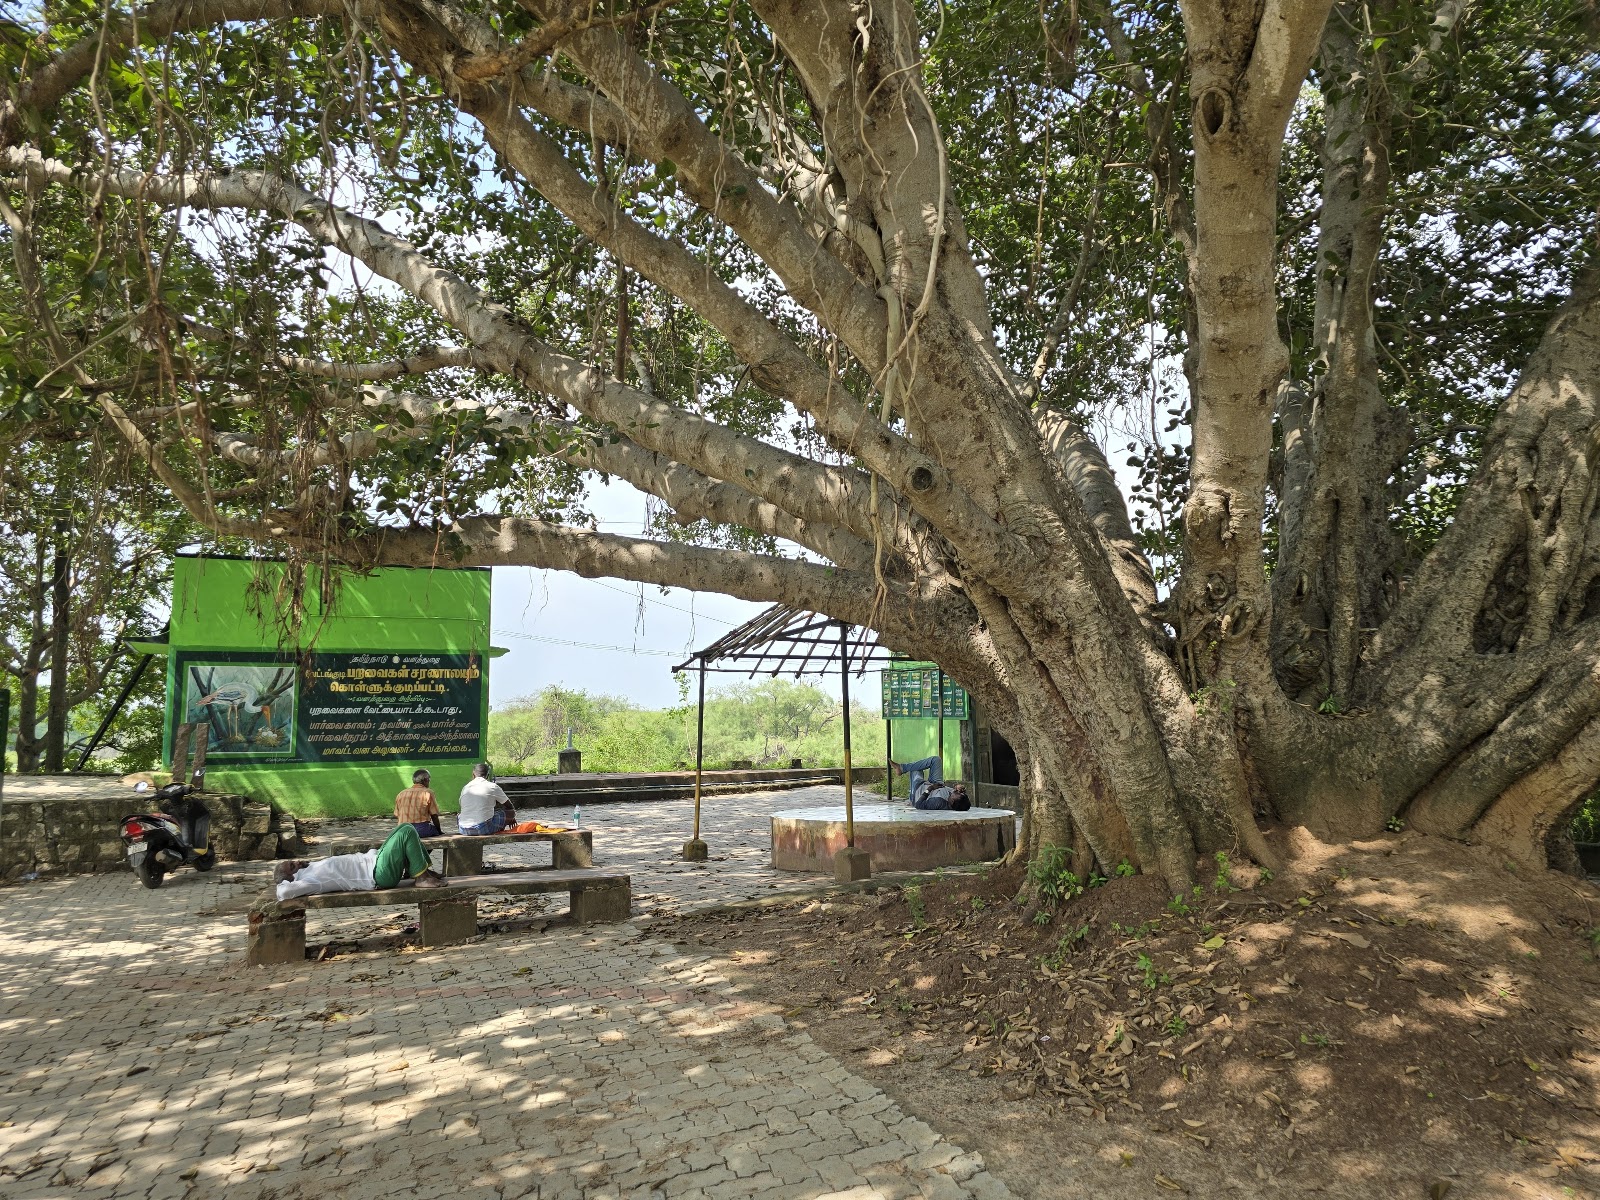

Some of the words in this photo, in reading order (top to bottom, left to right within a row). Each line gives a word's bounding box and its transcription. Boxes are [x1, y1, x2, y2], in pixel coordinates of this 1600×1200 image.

[347, 664, 410, 680] பறவைகள்
[410, 664, 480, 680] சரணாலயம்
[378, 719, 412, 730] நவம்பர்
[431, 718, 456, 728] மார்ச்
[375, 732, 420, 742] அதிகாலை
